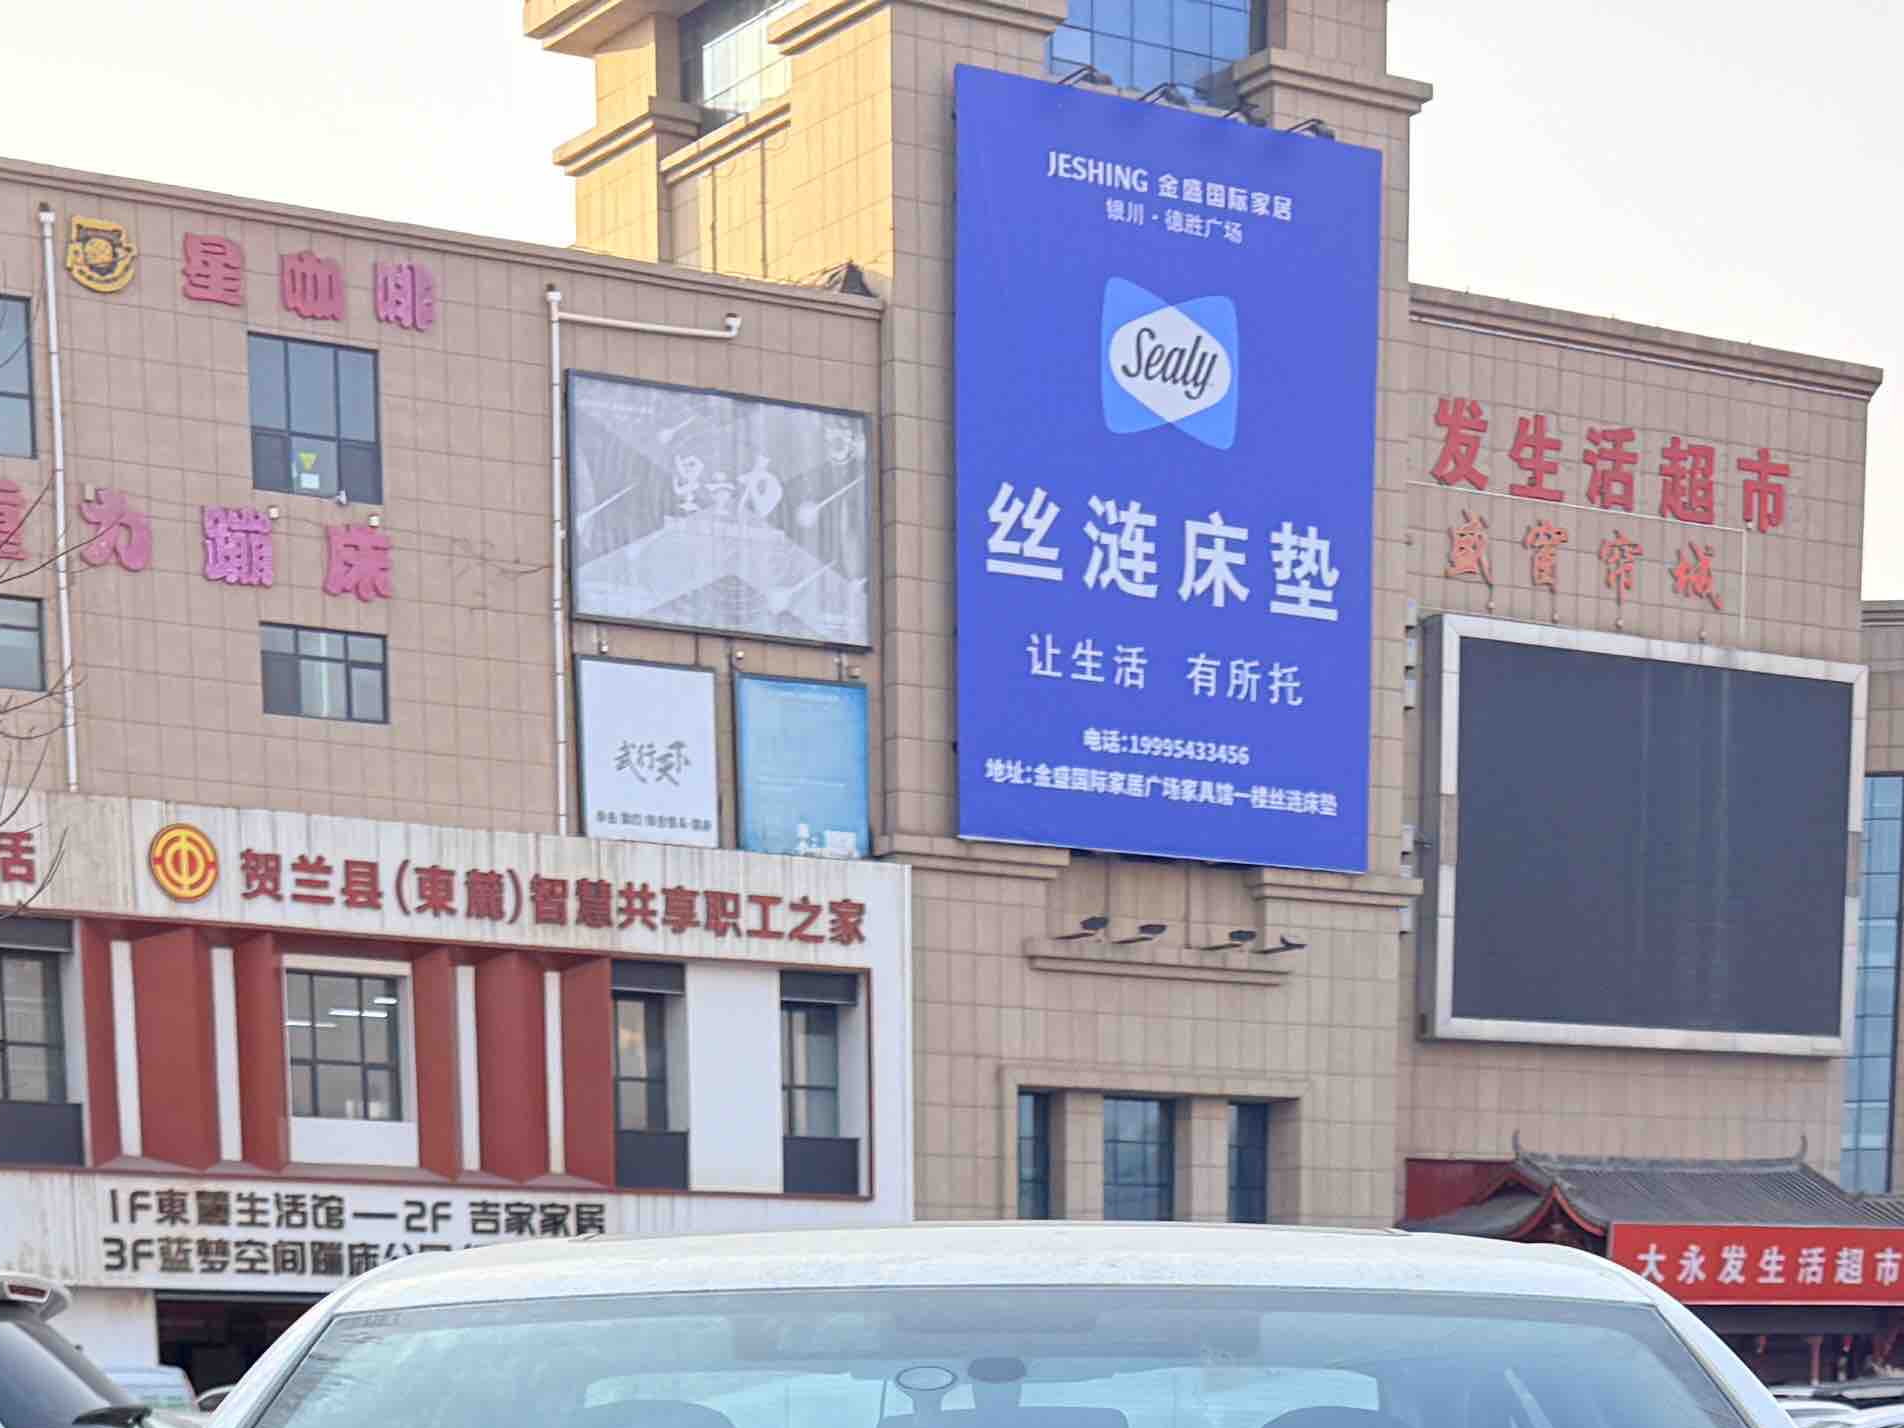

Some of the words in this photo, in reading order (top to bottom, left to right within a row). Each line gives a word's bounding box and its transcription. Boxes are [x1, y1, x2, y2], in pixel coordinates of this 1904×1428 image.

[1047, 151, 1148, 194] JESHING
[1157, 173, 1293, 222] 金盛国际家居
[182, 231, 437, 332] 星咖啡
[1121, 327, 1218, 400] Sealy
[1429, 397, 1791, 534] 发生活超市
[985, 481, 1340, 622] 丝涟床垫
[1025, 632, 1148, 690] 让生活
[1186, 652, 1304, 707] 有所托
[1635, 1242, 1904, 1287] 大永发生活超市
